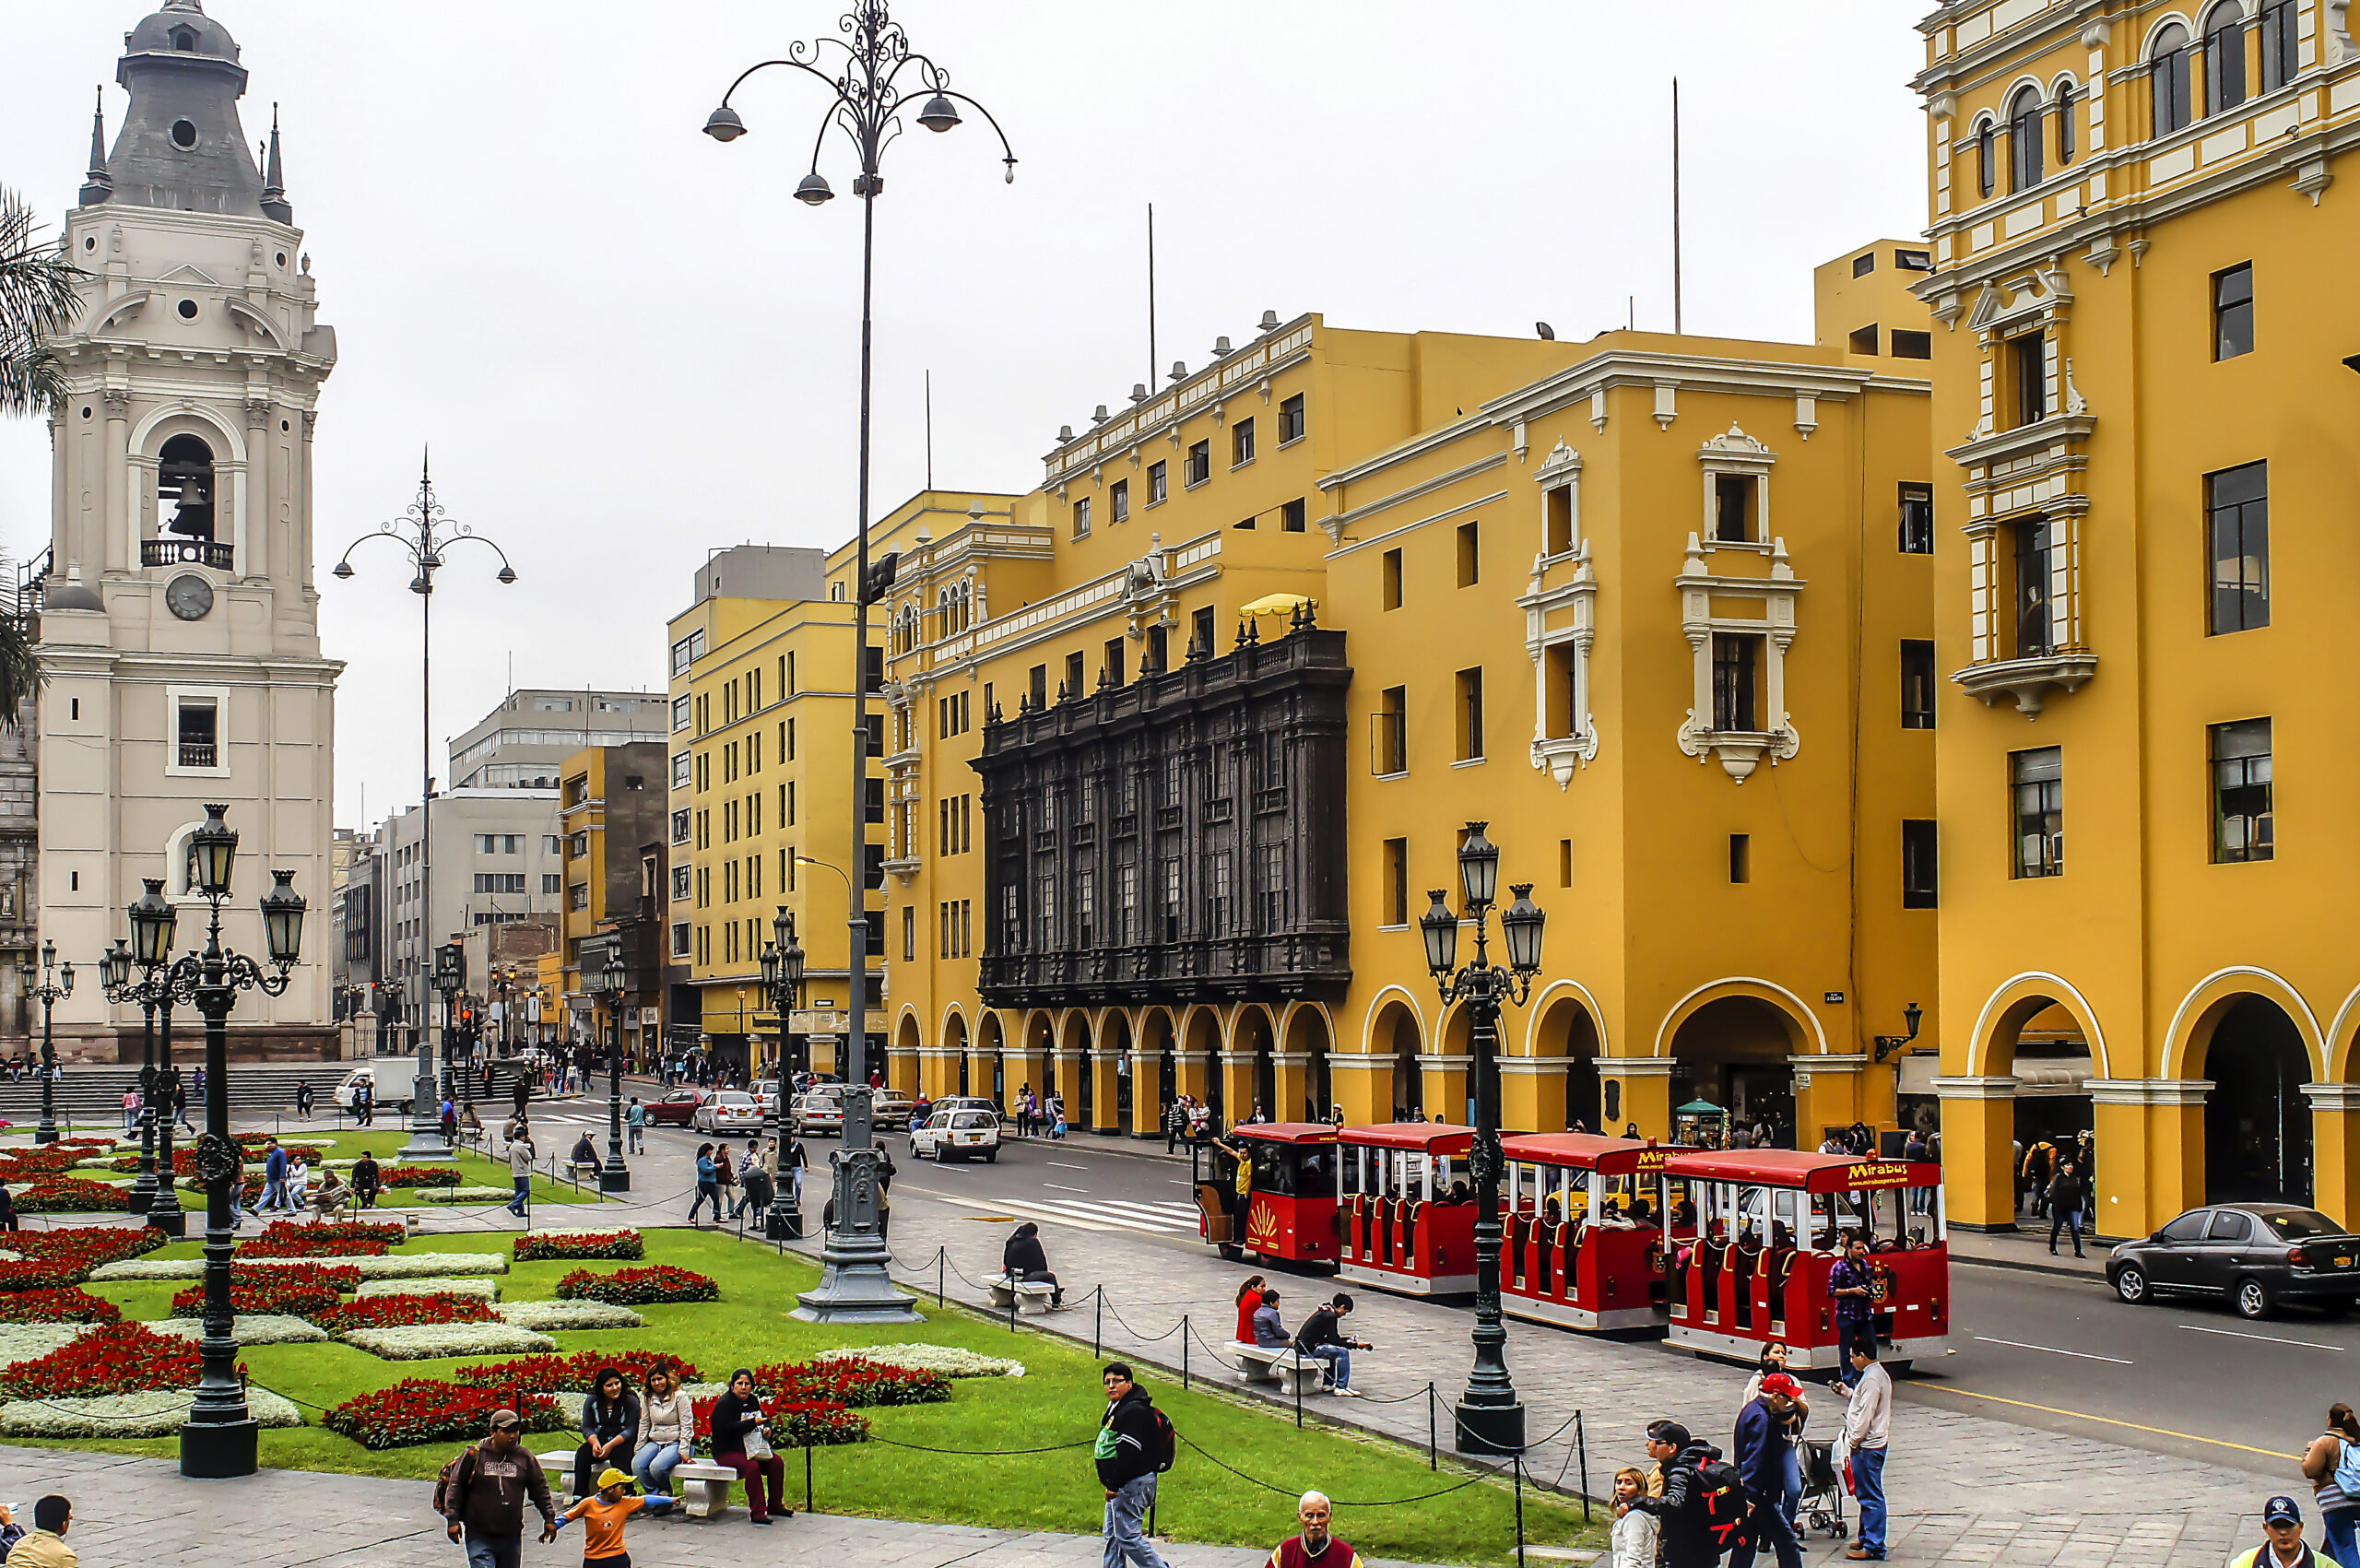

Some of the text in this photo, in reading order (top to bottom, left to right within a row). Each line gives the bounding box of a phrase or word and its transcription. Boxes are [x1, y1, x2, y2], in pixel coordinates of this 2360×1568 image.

[1638, 1151, 1692, 1164] Mirab
[1848, 1163, 1907, 1179] Mirabus
[1848, 1177, 1907, 1186] www.mirabusperu.com
